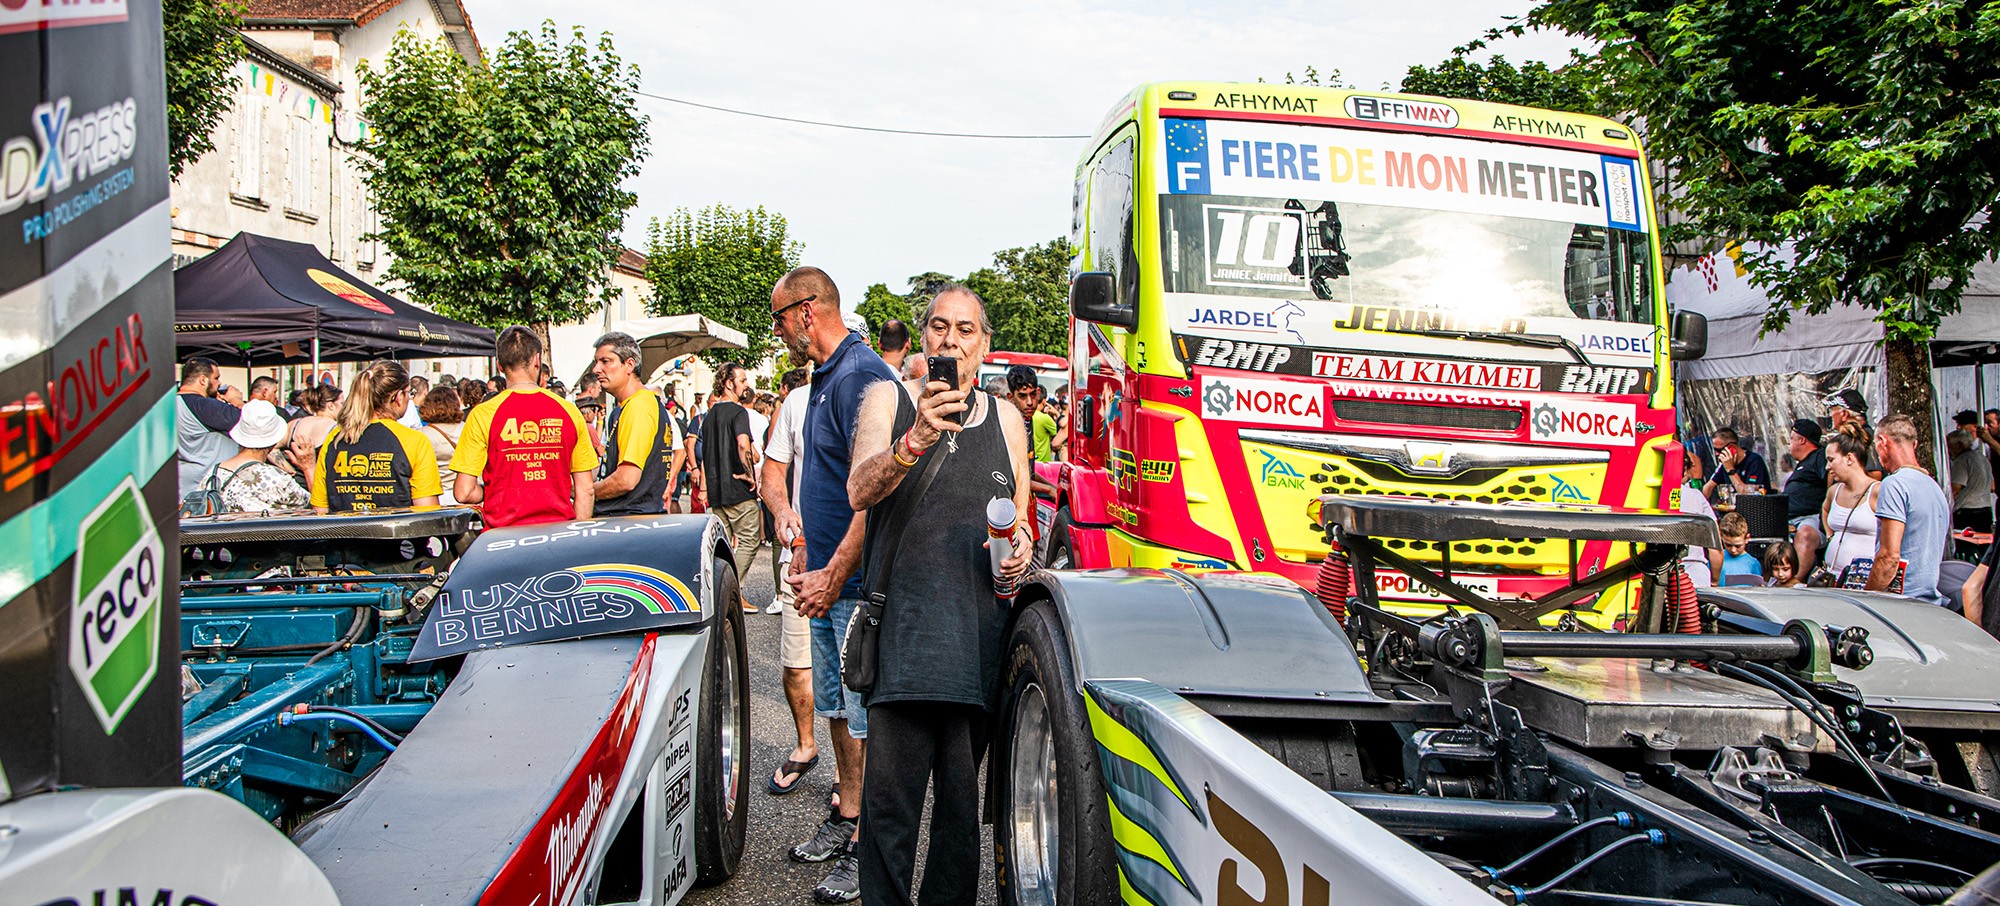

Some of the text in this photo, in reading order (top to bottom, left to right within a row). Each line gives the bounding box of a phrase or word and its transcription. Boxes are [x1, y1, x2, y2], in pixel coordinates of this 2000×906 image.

[1214, 93, 1318, 113] AFHYMAT
[1353, 97, 1450, 123] EFFIWAY
[1493, 115, 1586, 139] AFHYMAT
[1177, 162, 1201, 190] F
[1222, 139, 1600, 207] FIERE DE MON METIER
[22, 211, 55, 244] PRO
[1216, 212, 1300, 268] 10
[1188, 308, 1278, 328] JARDEL
[1193, 338, 1291, 373] E2MTP
[1579, 334, 1651, 353] JARDEL
[1315, 354, 1541, 389] TEAM KIMMEL
[1558, 366, 1640, 394] E2MTP
[1236, 389, 1321, 418] NORCA
[541, 427, 561, 436] ANS
[1561, 411, 1634, 437] NORCA
[370, 461, 391, 470] ANS
[505, 451, 560, 462] TRUCK RACIN
[336, 485, 394, 494] TRUCK RACING
[523, 470, 547, 481] 1983
[1268, 476, 1305, 490] BANK
[486, 520, 682, 552] SOPINAL
[82, 546, 156, 669] reca
[440, 570, 585, 618] LUXO
[435, 592, 634, 646] BENNES
[669, 687, 691, 728] JPS
[663, 855, 687, 906] HAFA
